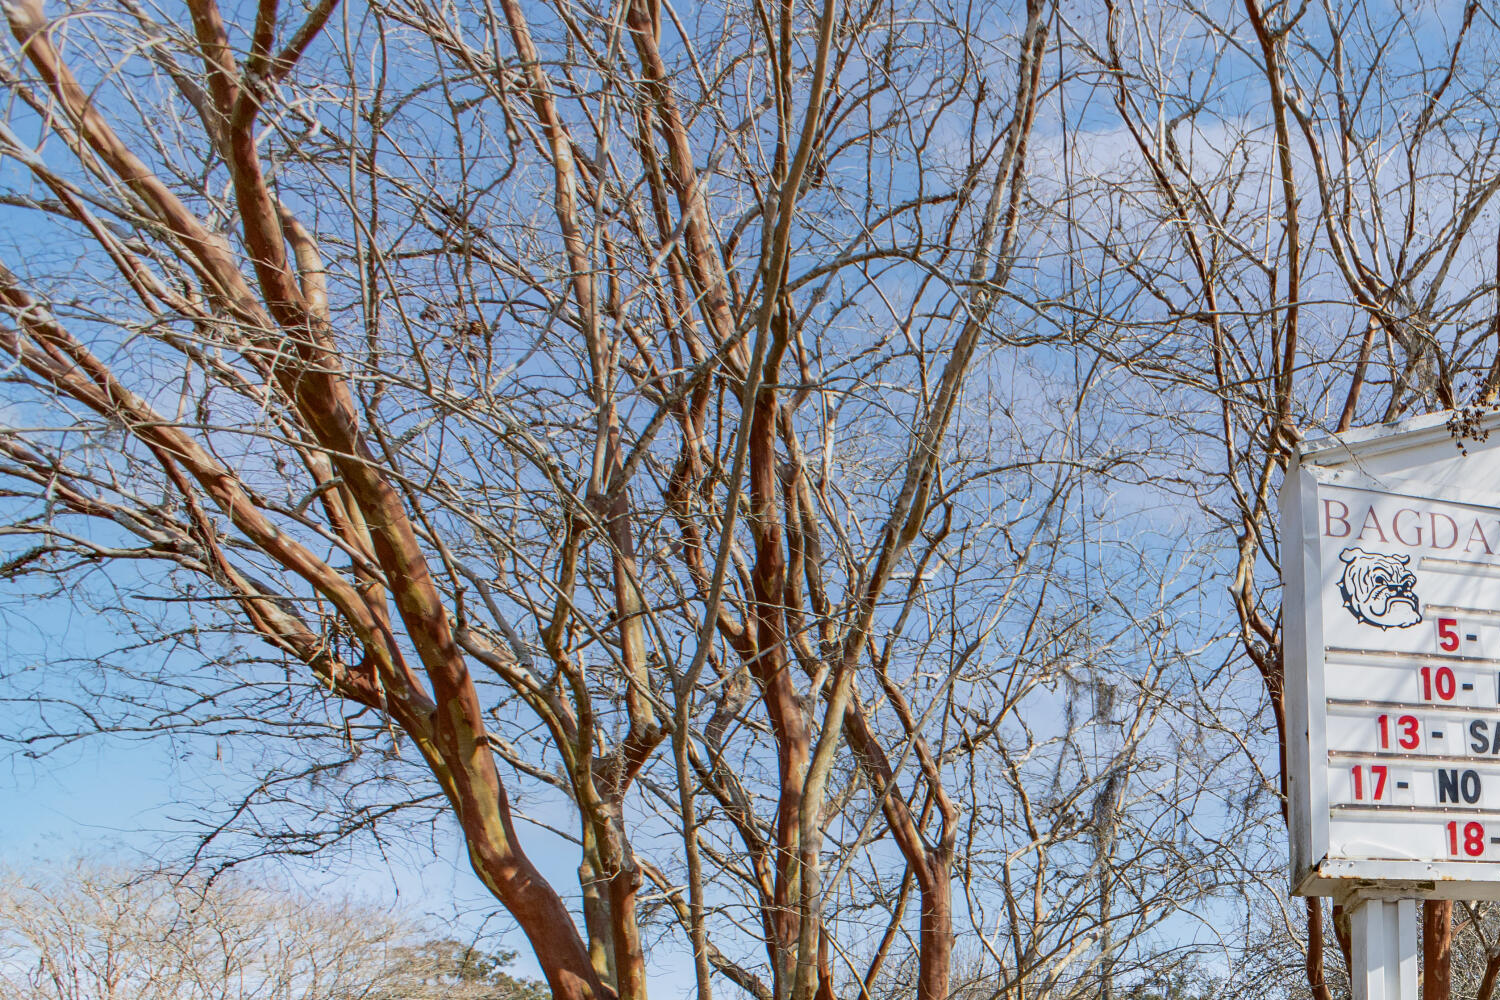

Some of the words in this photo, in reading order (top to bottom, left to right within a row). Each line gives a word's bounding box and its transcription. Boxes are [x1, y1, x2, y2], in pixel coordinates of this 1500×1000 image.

[1439, 618, 1477, 651] 5-
[1421, 667, 1473, 702] 10-
[1378, 715, 1443, 750] 13-
[1351, 765, 1408, 800] 17-
[1438, 770, 1481, 804] NO
[1447, 821, 1500, 856] 18-
